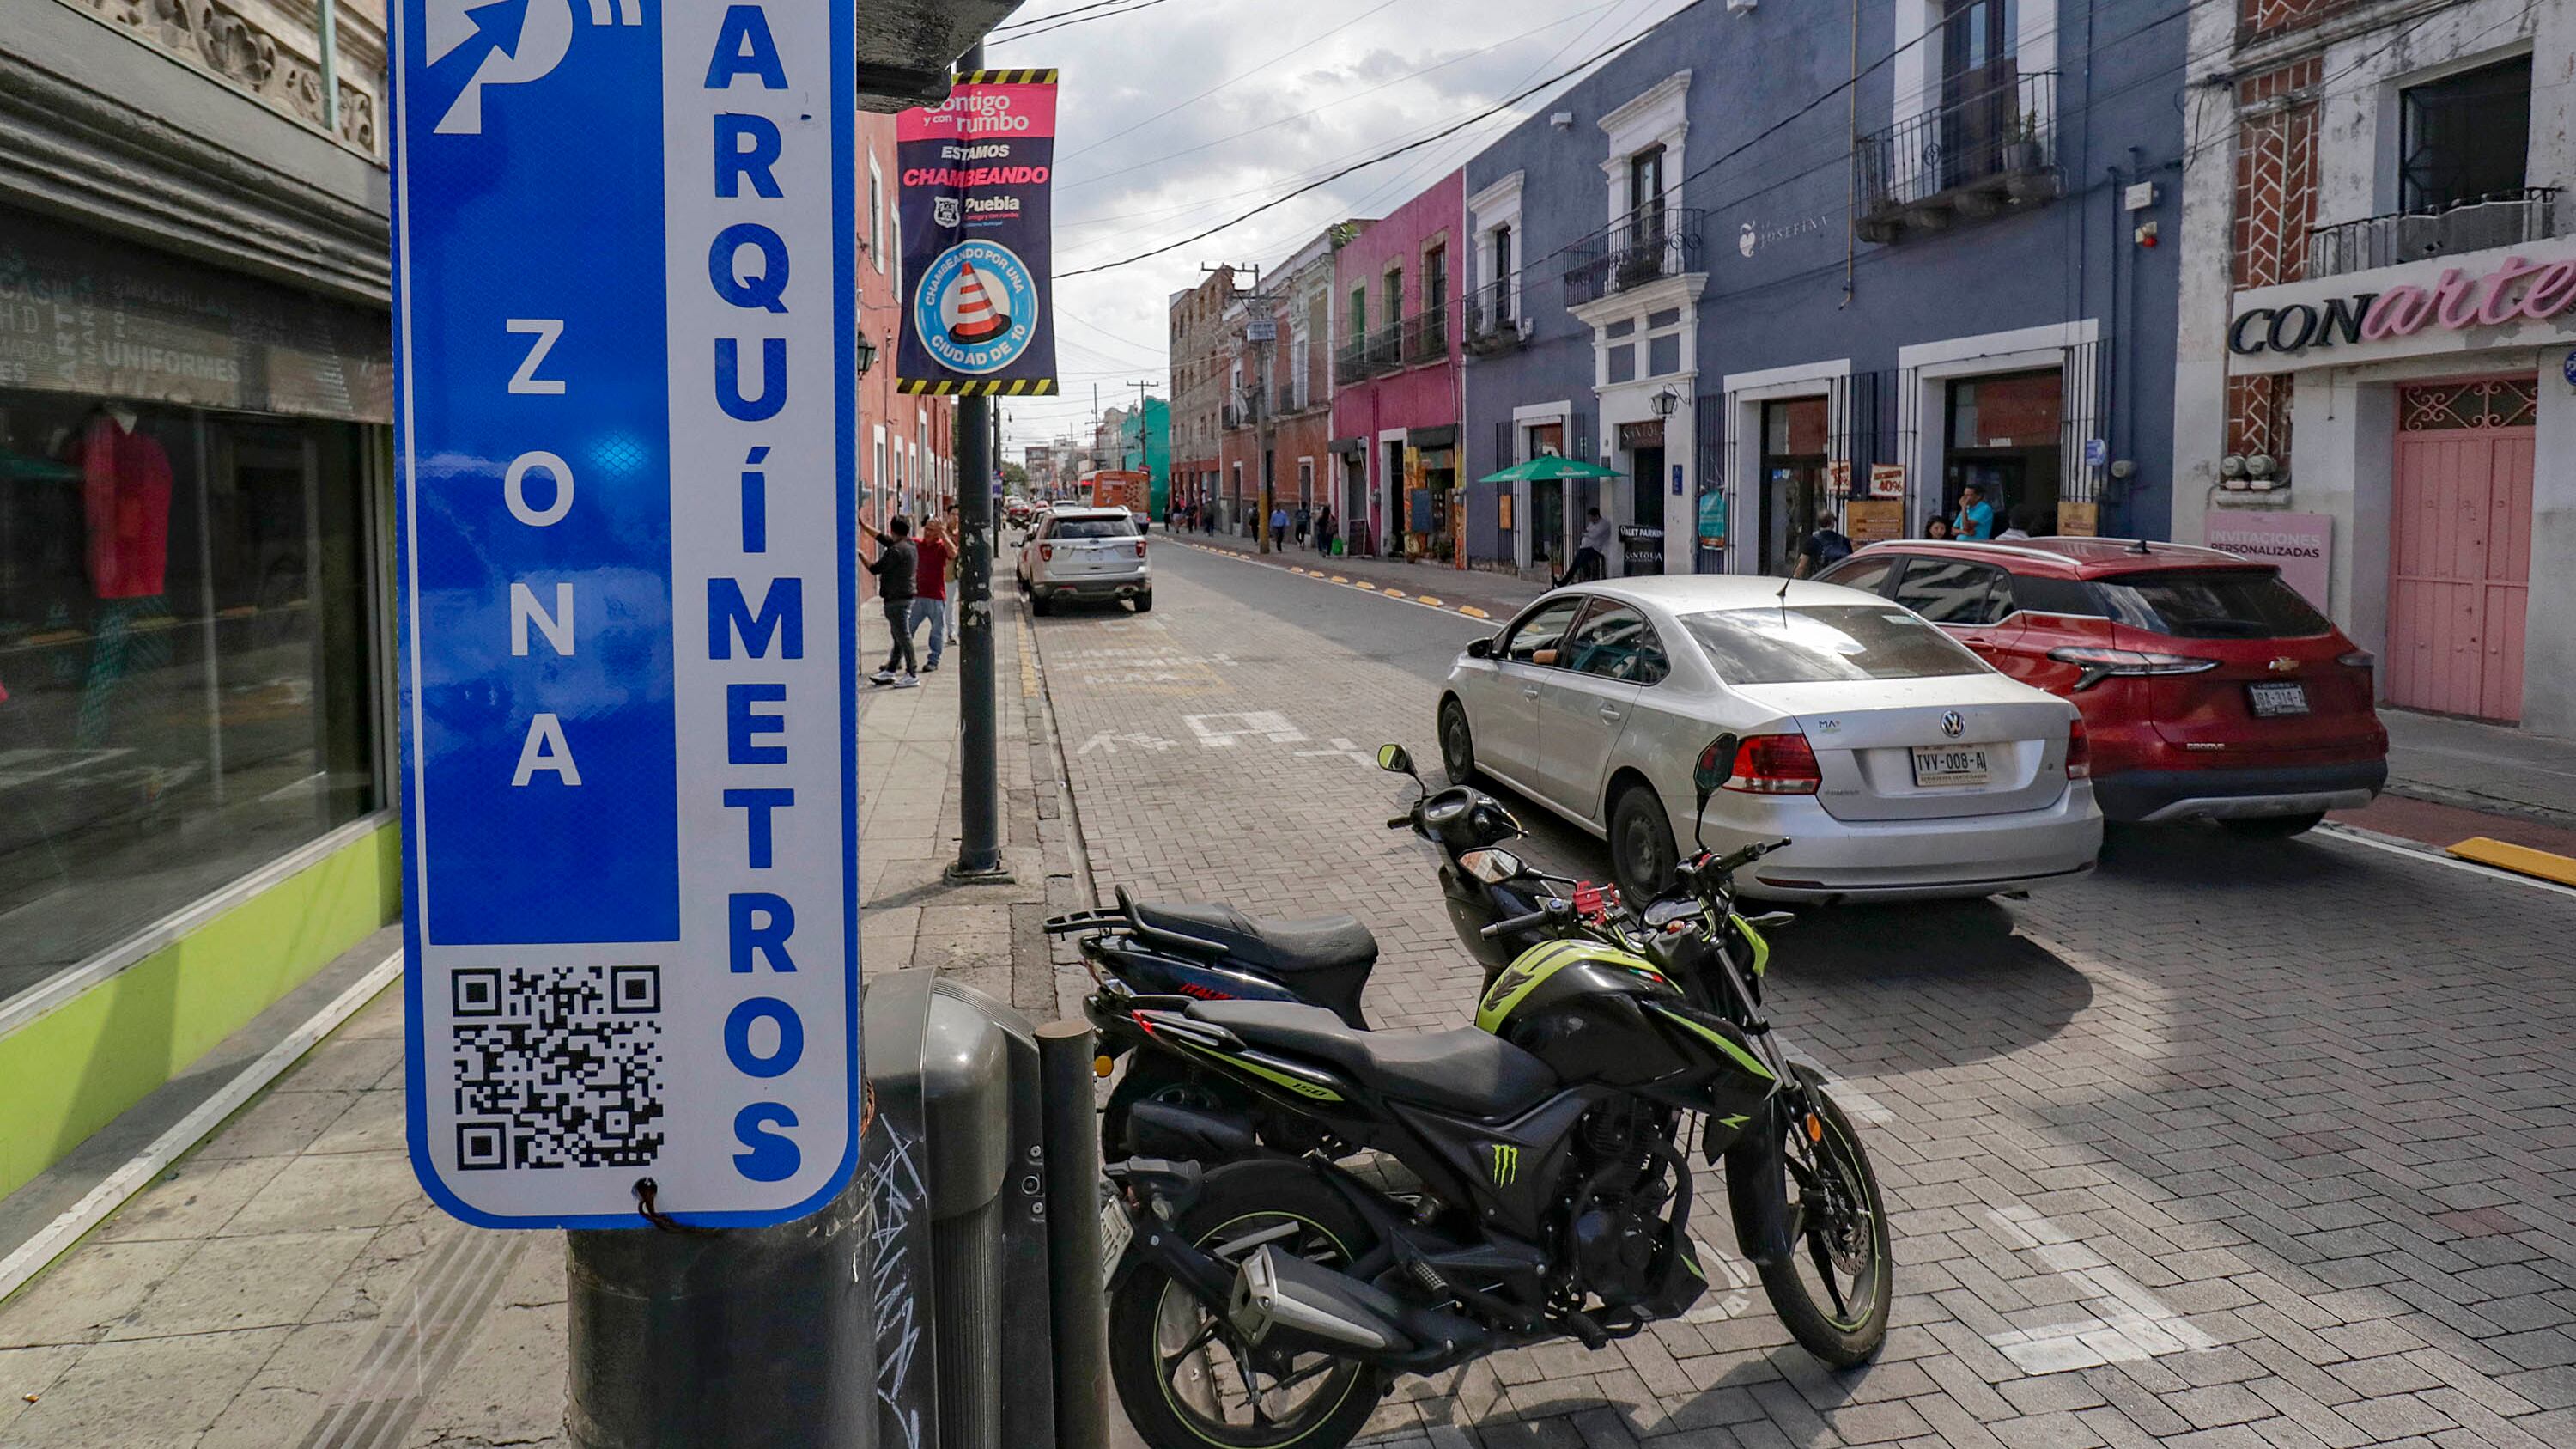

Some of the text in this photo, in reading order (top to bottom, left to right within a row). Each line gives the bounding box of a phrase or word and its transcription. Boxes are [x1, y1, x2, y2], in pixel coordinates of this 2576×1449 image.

[923, 90, 1010, 116] ontigo
[923, 112, 1030, 133] y con rumbo
[941, 144, 1010, 161] ESTAMOS
[903, 167, 1049, 187] CHAMBEANDO
[965, 196, 1020, 212] Puebla
[926, 248, 1024, 307] CHAMBEANDO POR UNA
[931, 324, 1026, 365] CIUDAD DE 10
[102, 340, 240, 384] UNIFORMES
[2211, 530, 2320, 546] INVITACIONES
[503, 319, 582, 786] ZONA
[2210, 543, 2319, 557] PERSONALIZADAS
[1292, 1082, 1328, 1096] 150
